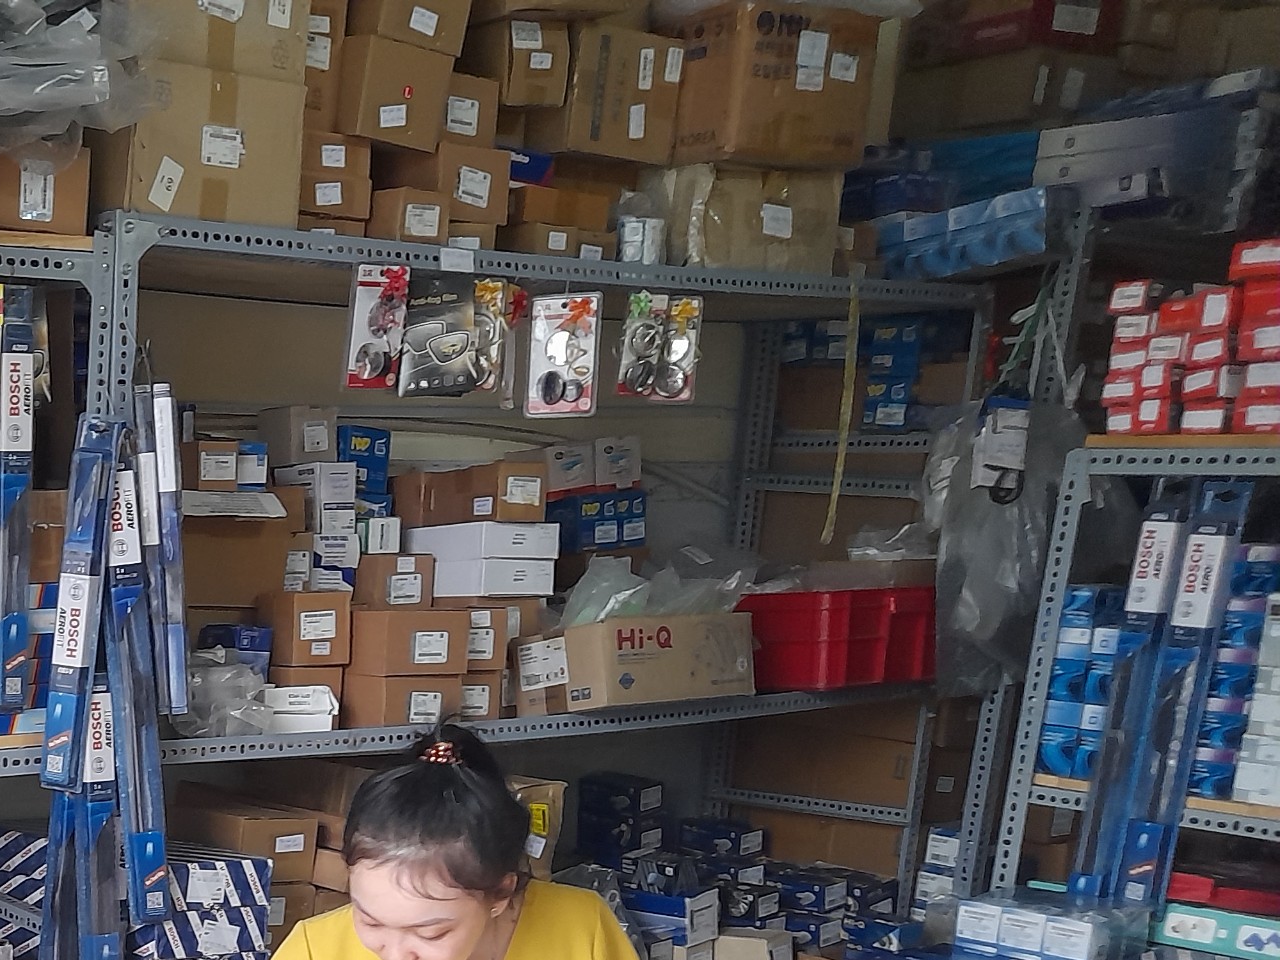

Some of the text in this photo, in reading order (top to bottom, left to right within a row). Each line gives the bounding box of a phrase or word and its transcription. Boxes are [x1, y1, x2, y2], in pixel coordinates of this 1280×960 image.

[9, 362, 22, 417] BOSCH
[23, 372, 32, 416] AEROFIT
[1136, 529, 1158, 580] BOSCH
[1184, 542, 1206, 594] BOSCH
[57, 607, 67, 648] AEROFIT
[65, 607, 82, 659] BOSCH
[616, 625, 673, 650] Hi-Q
[91, 701, 102, 750] BOSCH
[104, 710, 113, 749] AEROFIT
[167, 926, 181, 950] BOSCH
